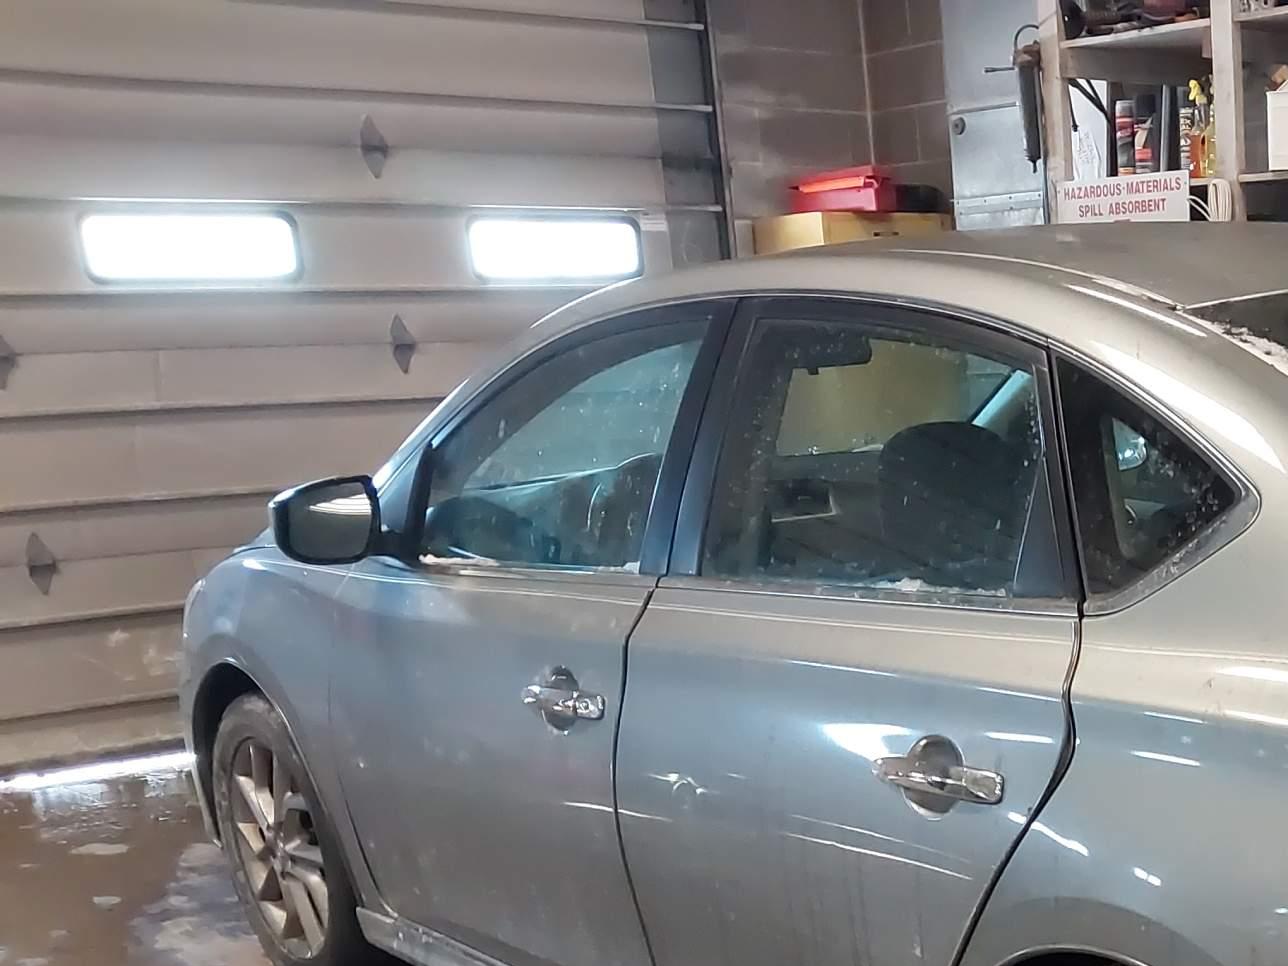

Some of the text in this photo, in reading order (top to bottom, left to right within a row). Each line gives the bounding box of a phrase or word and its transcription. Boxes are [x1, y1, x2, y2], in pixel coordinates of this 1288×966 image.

[1063, 176, 1181, 201] HAZARDOUS MATERIALS
[1078, 198, 1167, 218] SPILL ABSORBENT
